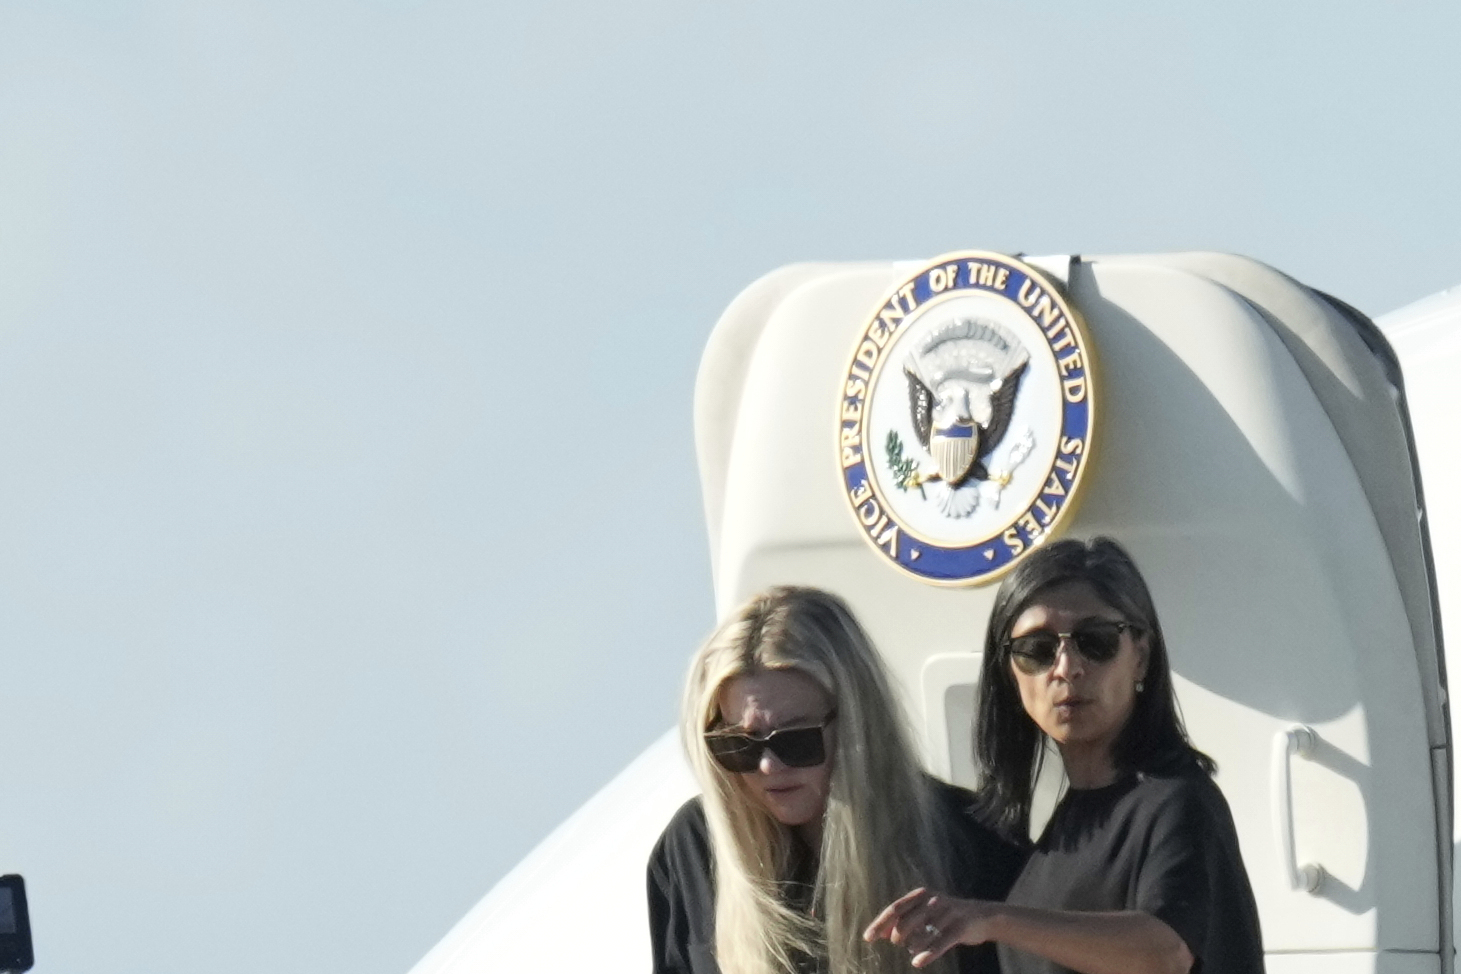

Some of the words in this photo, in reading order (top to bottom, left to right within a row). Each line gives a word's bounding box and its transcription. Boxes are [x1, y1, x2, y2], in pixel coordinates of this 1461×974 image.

[929, 263, 960, 292] OF
[967, 261, 1009, 289] THE
[840, 282, 919, 469] PRESIDENT
[1018, 278, 1087, 404] UNITED
[850, 478, 899, 558] VICE
[1003, 435, 1084, 557] STATES
